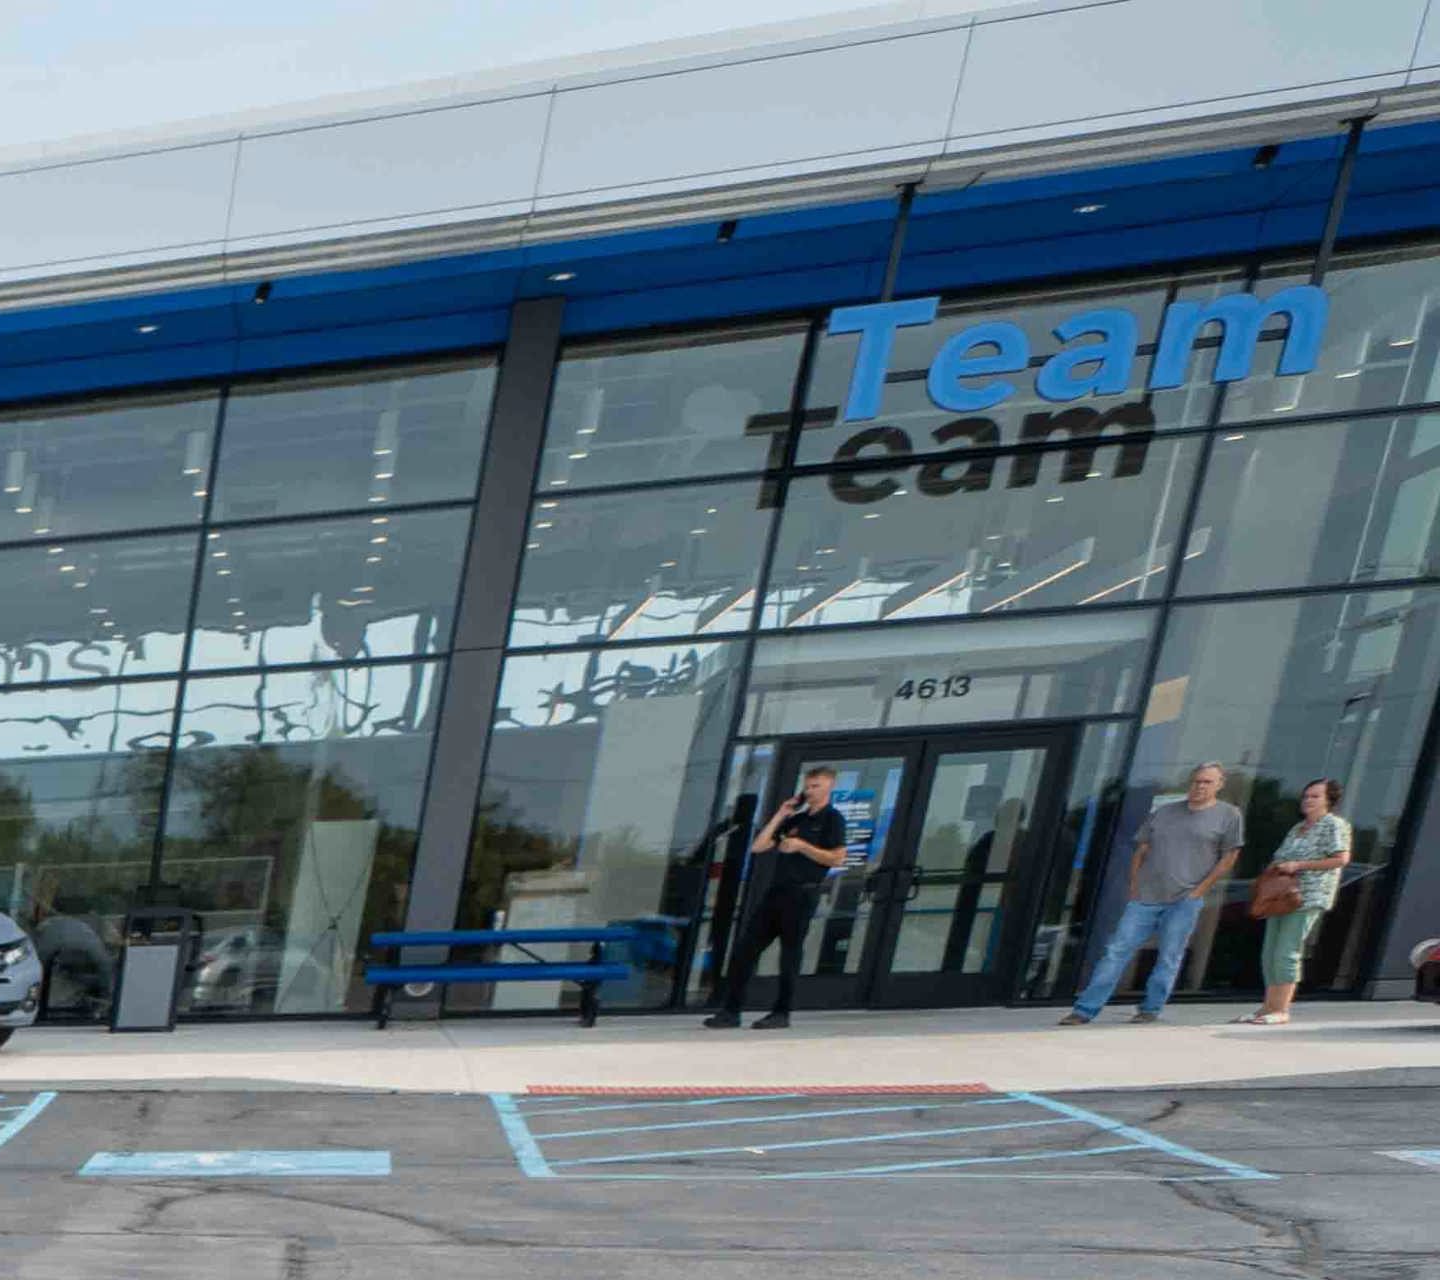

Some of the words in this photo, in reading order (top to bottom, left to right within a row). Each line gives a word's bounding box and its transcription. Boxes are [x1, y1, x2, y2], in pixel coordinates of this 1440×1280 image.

[826, 285, 1331, 421] Team
[745, 402, 1156, 510] Team
[894, 675, 972, 700] 4613
